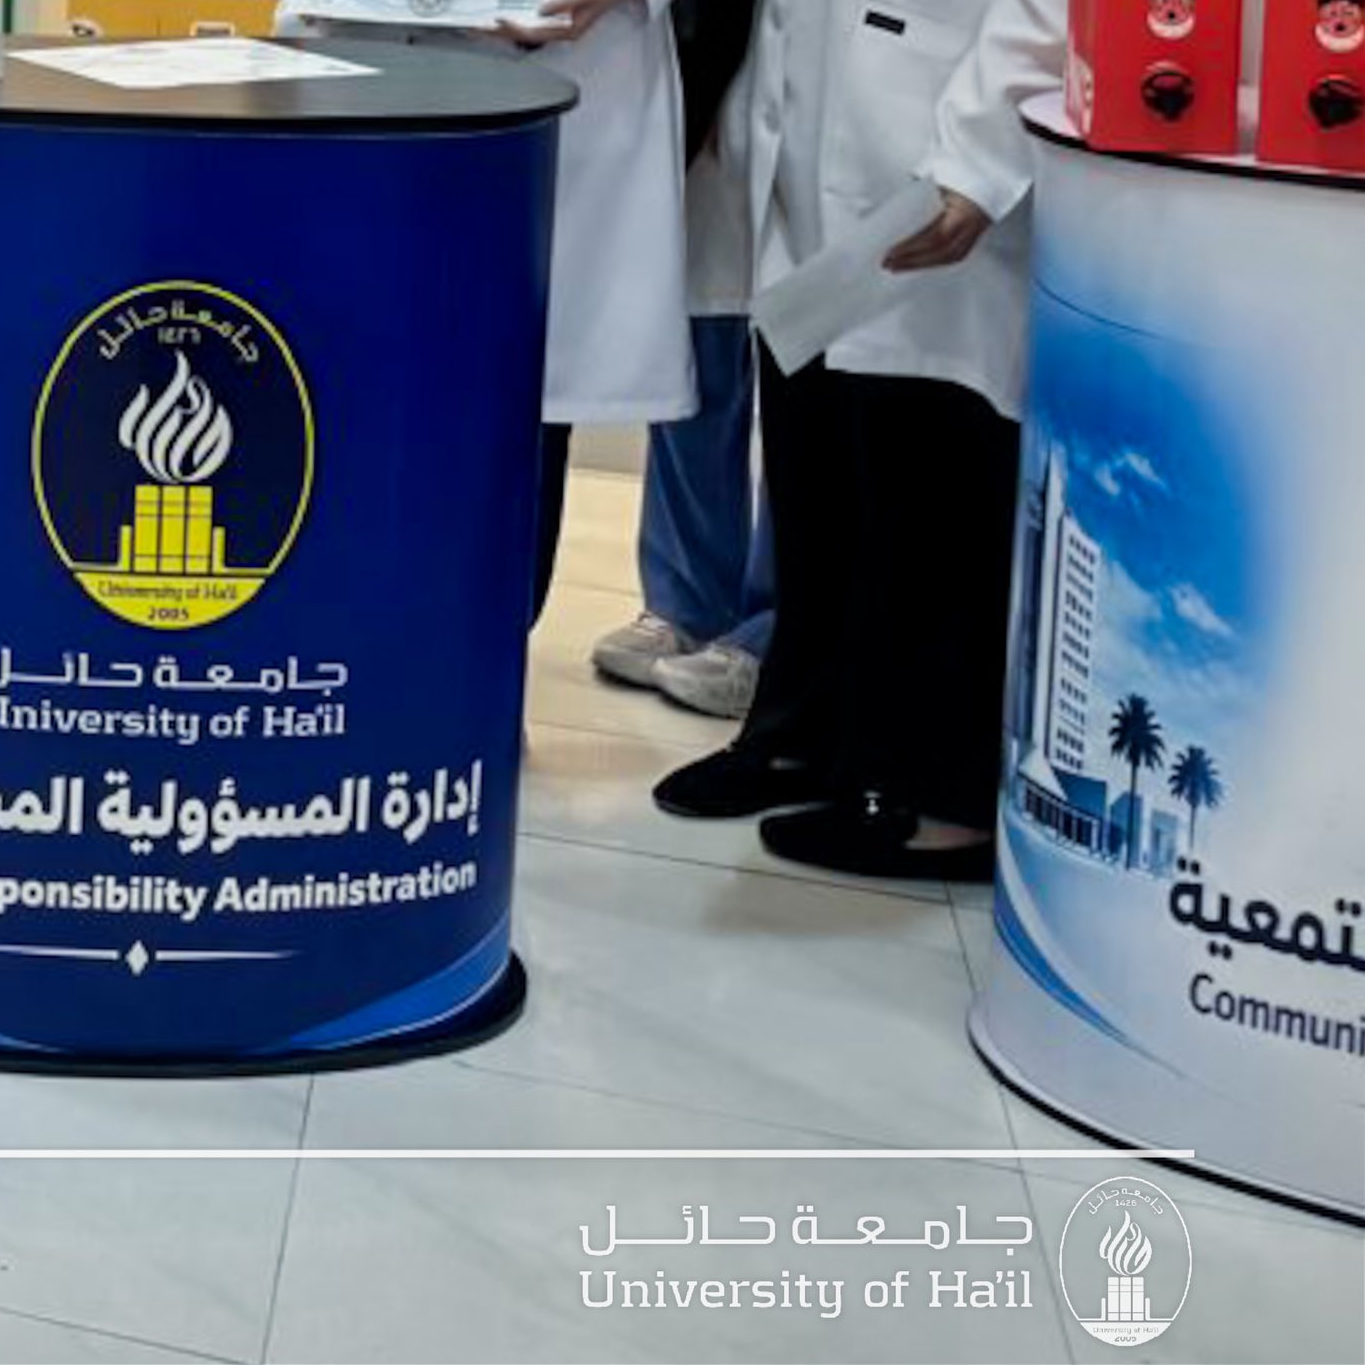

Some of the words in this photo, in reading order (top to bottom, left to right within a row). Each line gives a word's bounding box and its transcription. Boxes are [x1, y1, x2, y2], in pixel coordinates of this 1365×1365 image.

[97, 306, 168, 360] حائل
[171, 299, 259, 363] جامعة
[148, 606, 189, 621] 2005
[154, 653, 349, 697] جامعة
[210, 706, 251, 738] of
[263, 704, 347, 738] Ha'il
[97, 766, 371, 856] المسؤولية
[382, 758, 484, 843] إدارة
[214, 857, 477, 914] Administration
